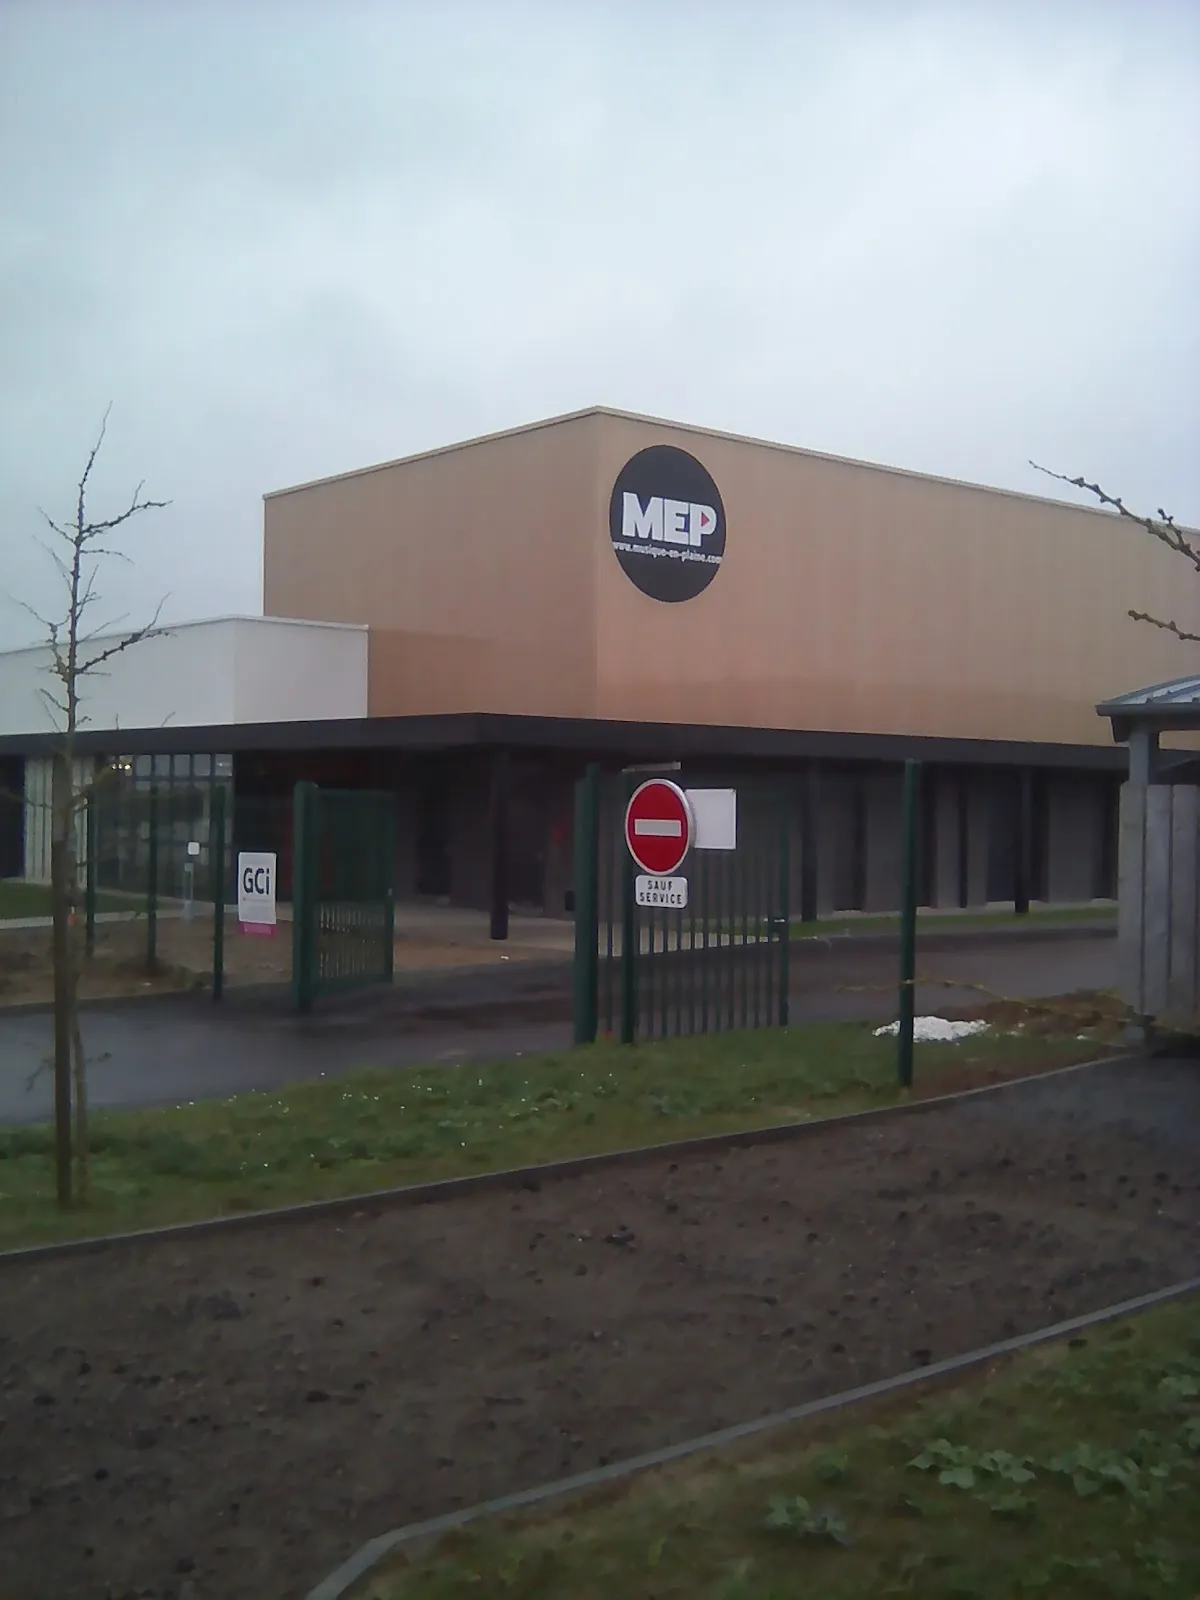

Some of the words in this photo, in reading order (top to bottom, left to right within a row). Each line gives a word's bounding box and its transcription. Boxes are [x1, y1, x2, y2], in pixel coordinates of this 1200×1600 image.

[622, 492, 717, 546] MEP
[647, 880, 673, 891] SAUF
[639, 892, 682, 905] SERVICE
